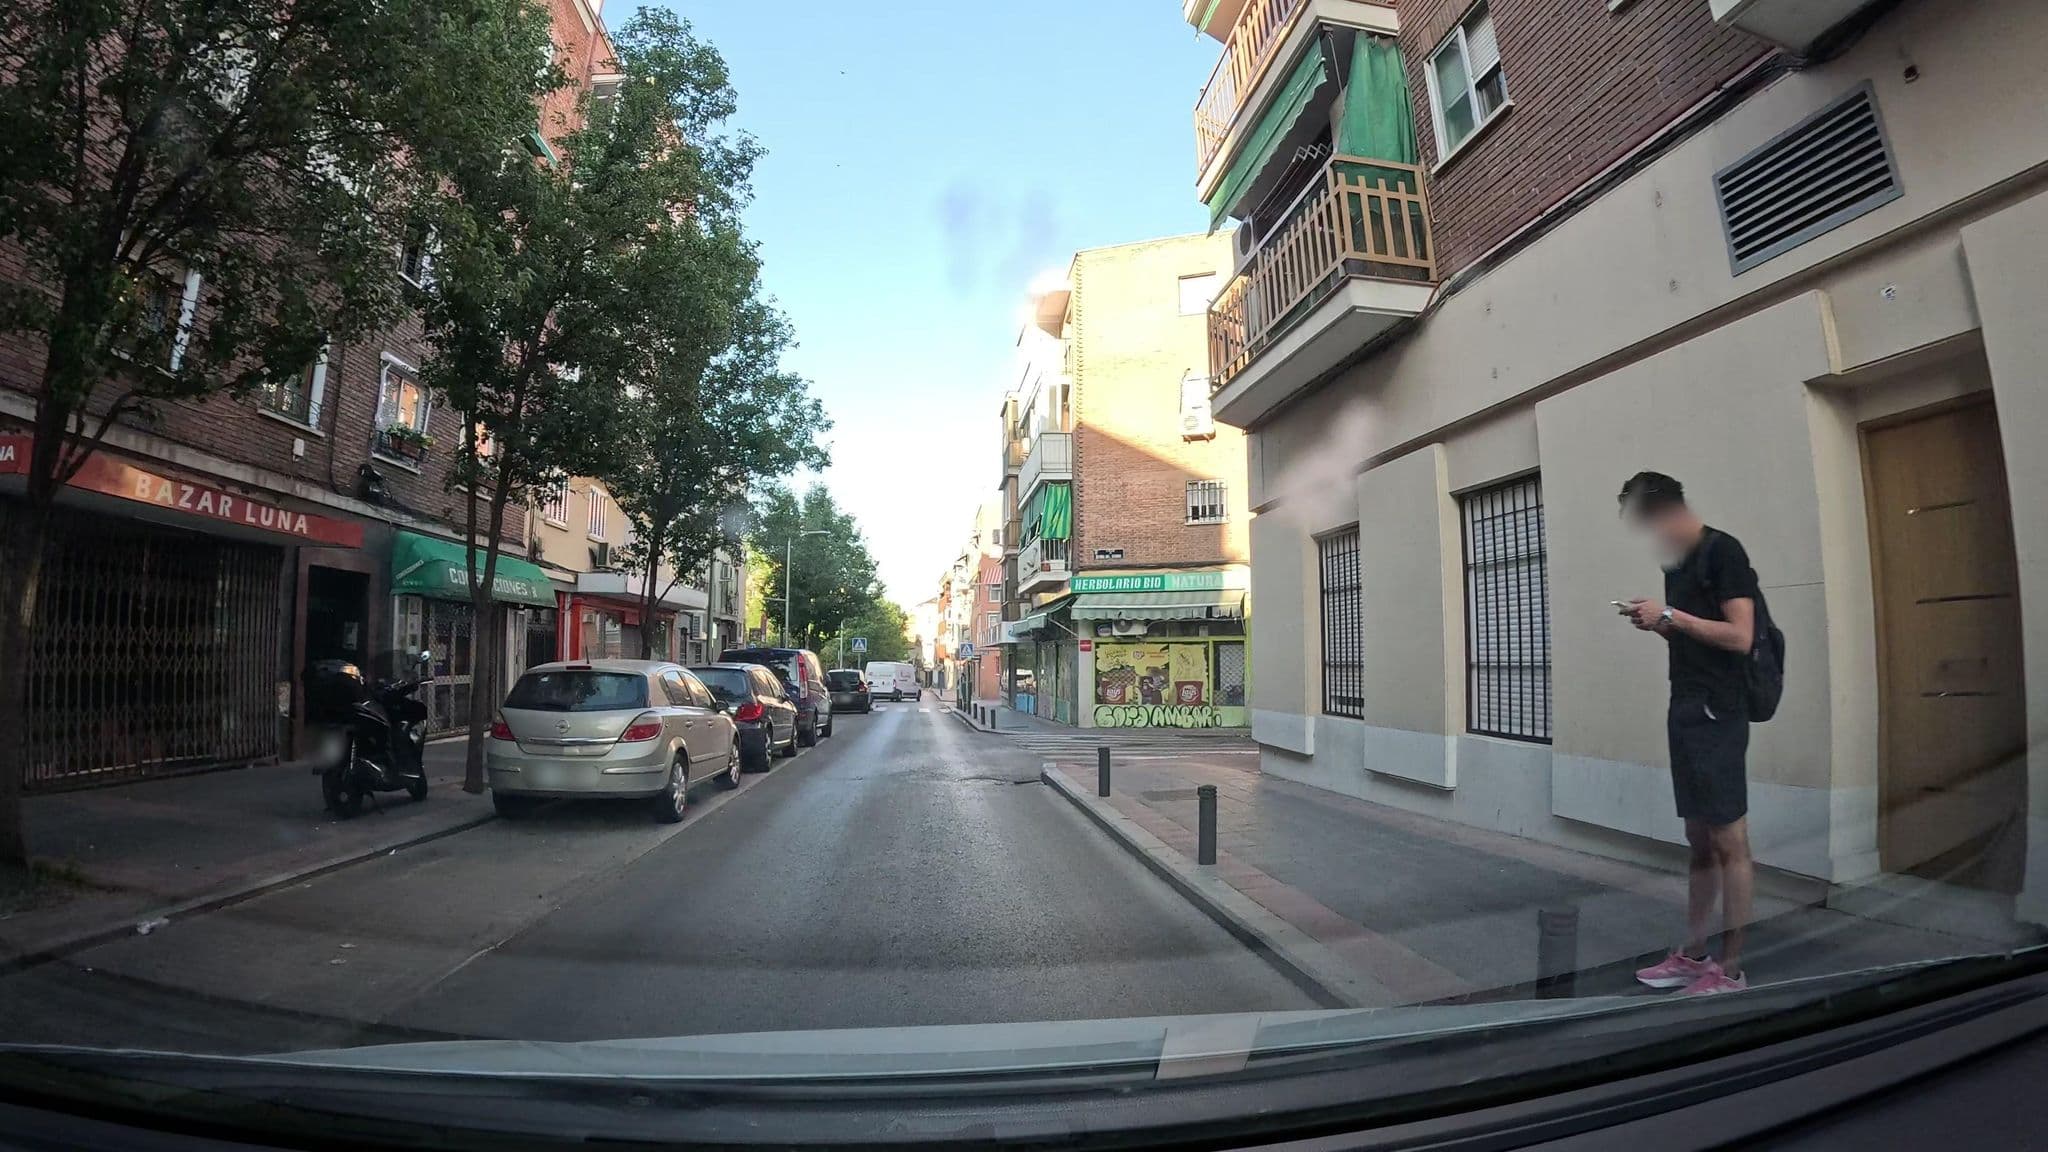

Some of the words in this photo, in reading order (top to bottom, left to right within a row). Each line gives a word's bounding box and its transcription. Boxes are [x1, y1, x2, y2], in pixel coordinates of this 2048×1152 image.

[134, 474, 233, 518] BAZAR
[244, 501, 310, 535] LUNA
[1074, 577, 1141, 591] HERBOLARIO
[1143, 576, 1161, 589] BIO
